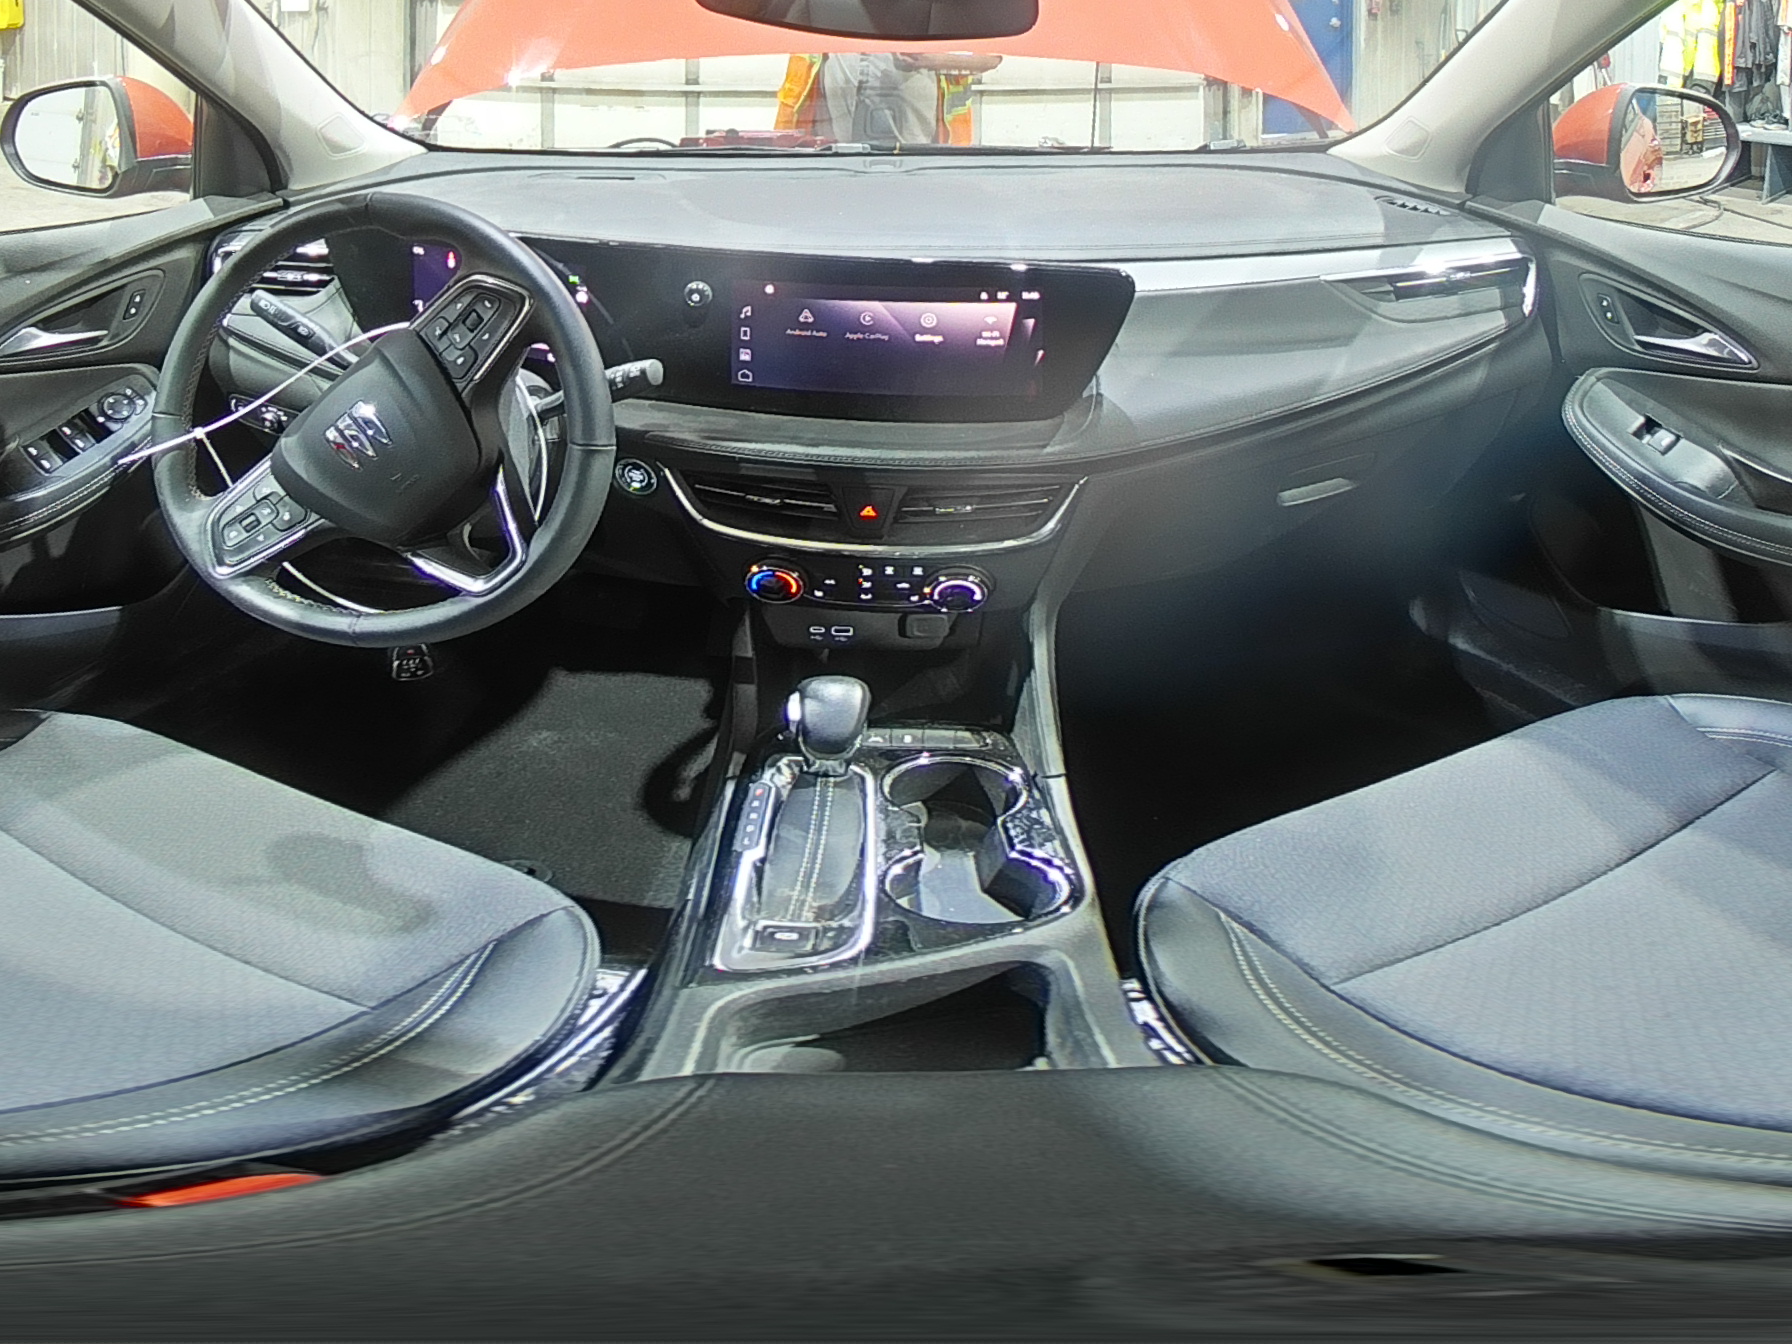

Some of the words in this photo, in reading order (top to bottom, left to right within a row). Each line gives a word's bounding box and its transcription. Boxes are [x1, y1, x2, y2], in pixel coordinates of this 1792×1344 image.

[785, 328, 811, 337] Android
[844, 331, 864, 341] Apple
[864, 332, 889, 341] CarPlay
